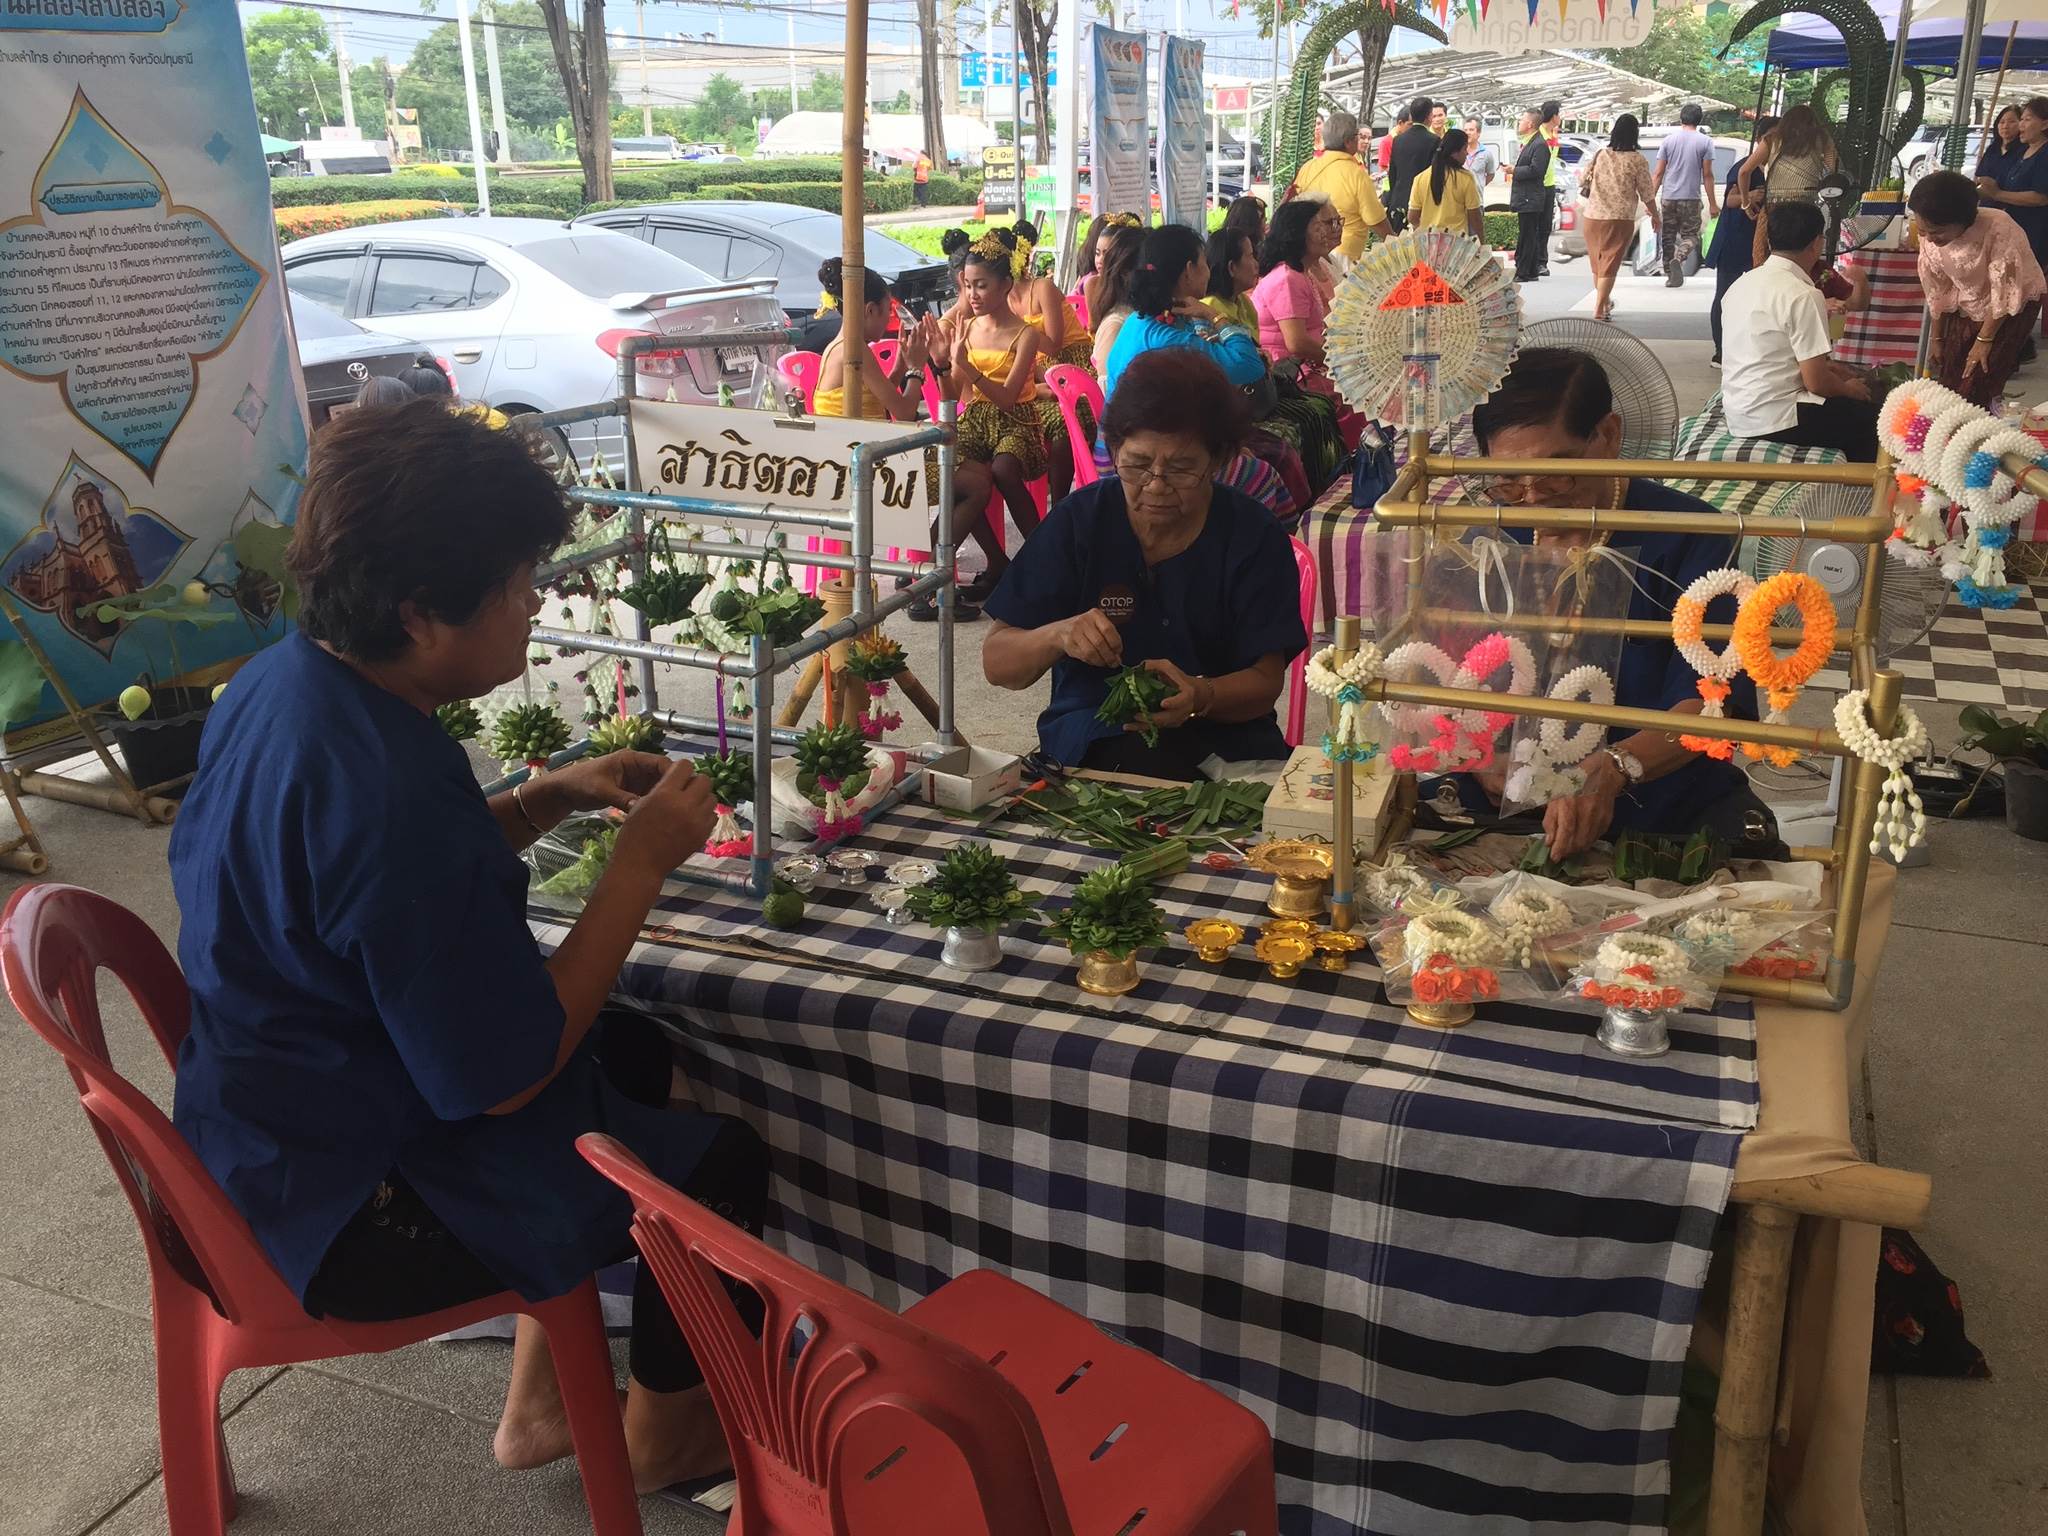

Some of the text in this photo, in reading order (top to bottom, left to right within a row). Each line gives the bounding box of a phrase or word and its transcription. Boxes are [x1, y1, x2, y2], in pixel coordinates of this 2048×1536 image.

[53, 51, 126, 68] อำเภอลำลูกกา
[129, 51, 193, 68] จังหวัดปทุมธานี
[1225, 91, 1239, 107] A
[99, 227, 110, 237] 10
[107, 260, 119, 270] 13
[37, 284, 49, 294] 55
[112, 294, 121, 304] 12
[657, 428, 919, 509] สาธิตอาพ
[1100, 598, 1134, 607] OTOP
